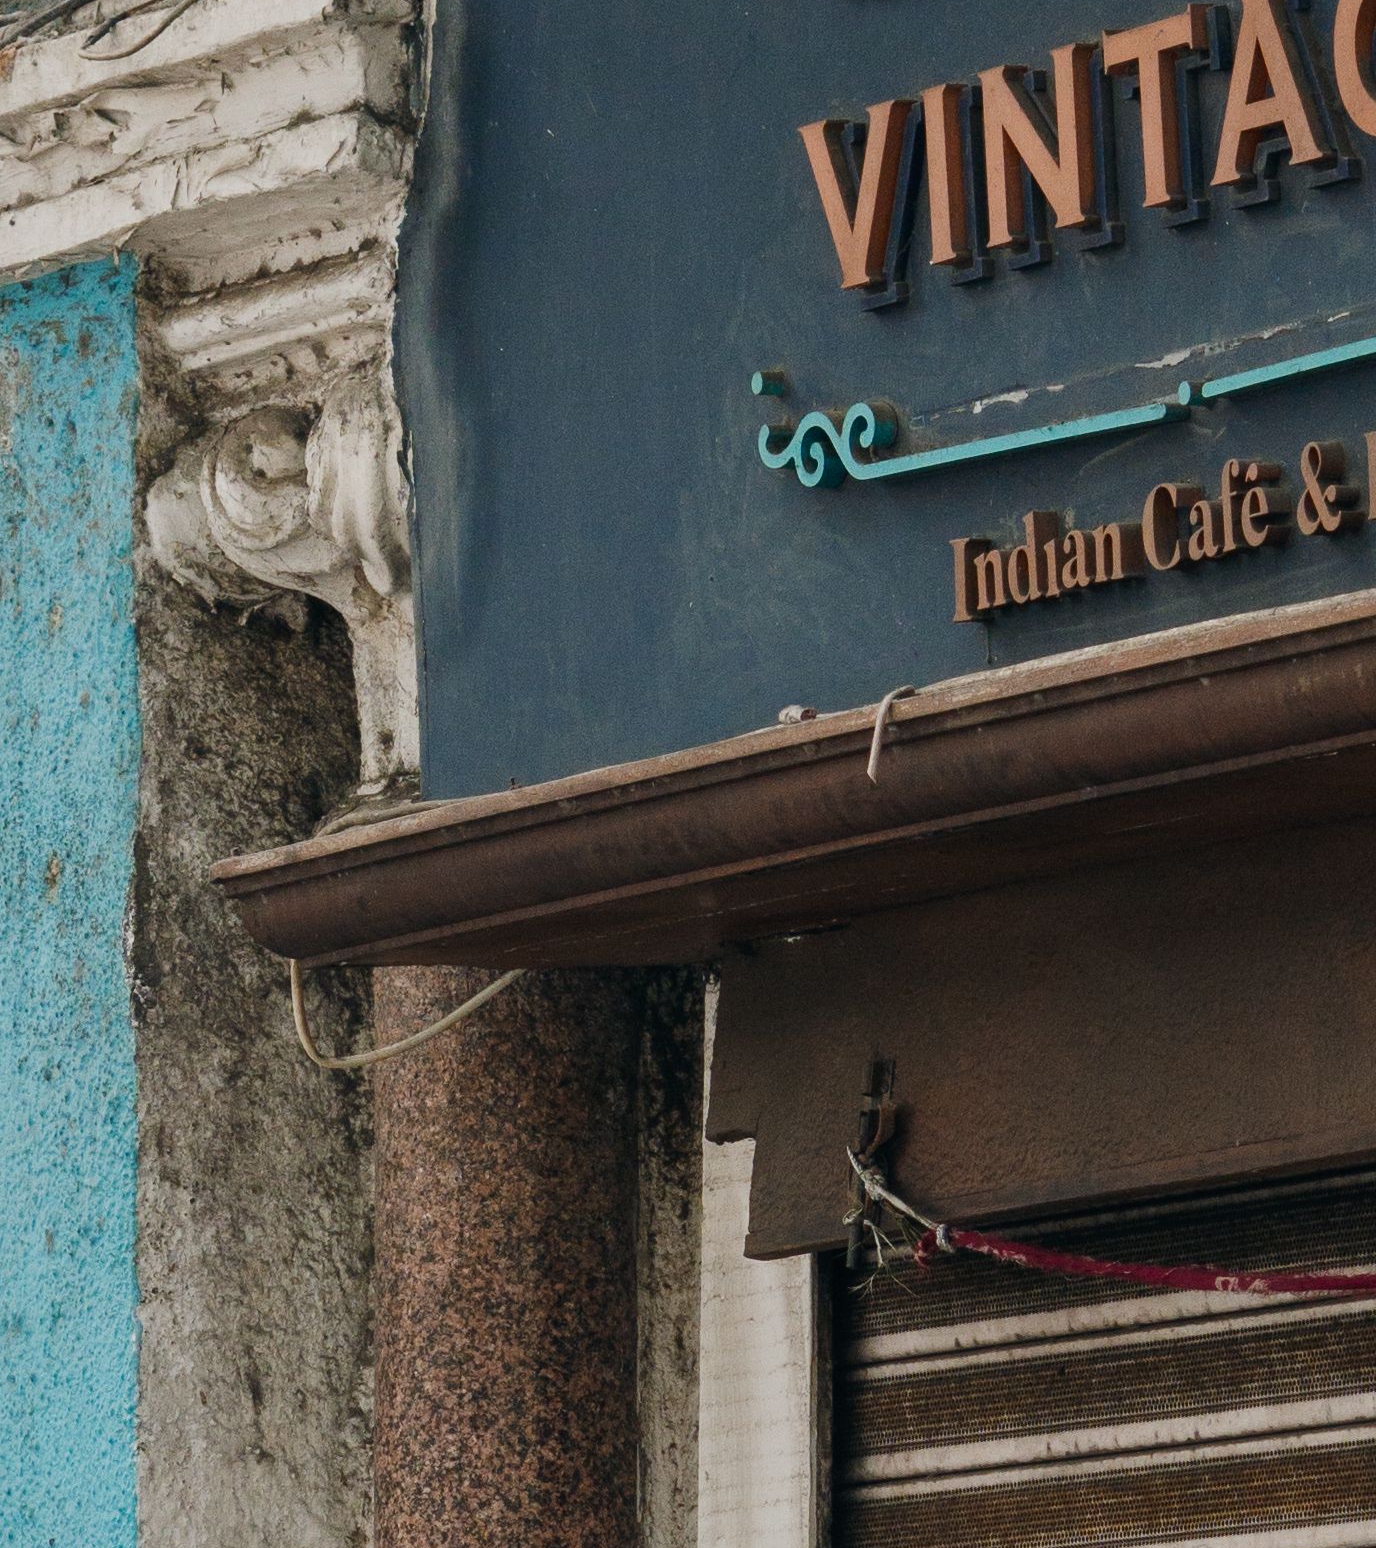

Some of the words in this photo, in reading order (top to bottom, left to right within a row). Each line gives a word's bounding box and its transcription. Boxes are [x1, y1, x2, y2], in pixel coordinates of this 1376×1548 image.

[949, 511, 1126, 622] Indian
[1142, 458, 1271, 571] Café
[1296, 440, 1342, 536] &
